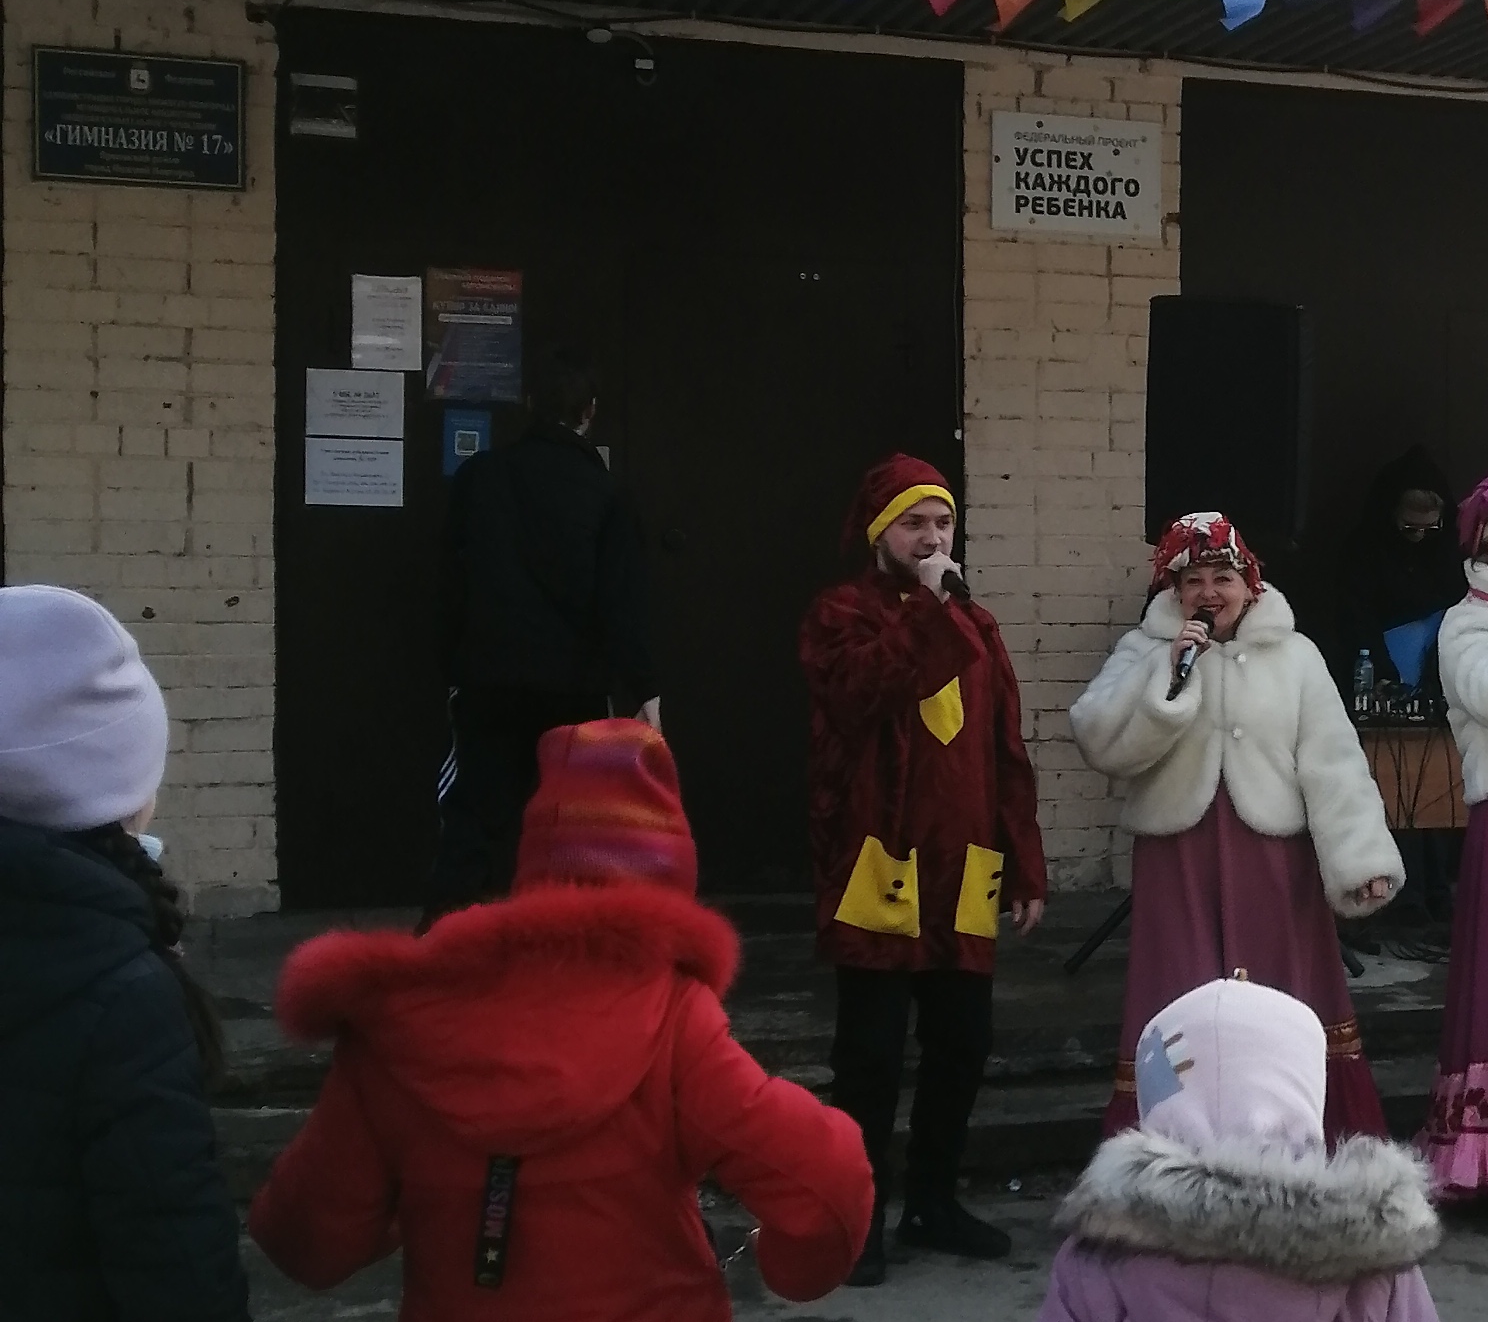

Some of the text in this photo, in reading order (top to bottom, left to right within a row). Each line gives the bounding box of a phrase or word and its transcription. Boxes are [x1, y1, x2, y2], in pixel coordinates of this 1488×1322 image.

[44, 123, 234, 155] «ГИМНАЗИЯ № 17»
[1014, 131, 1139, 148] ФЕДЕРАЛЬНЫЙ ПРОЕКТ
[1014, 146, 1094, 171] УСПЕХ
[1014, 170, 1141, 199] КАЖДОГО
[1014, 194, 1128, 220] РЕБЕНКА
